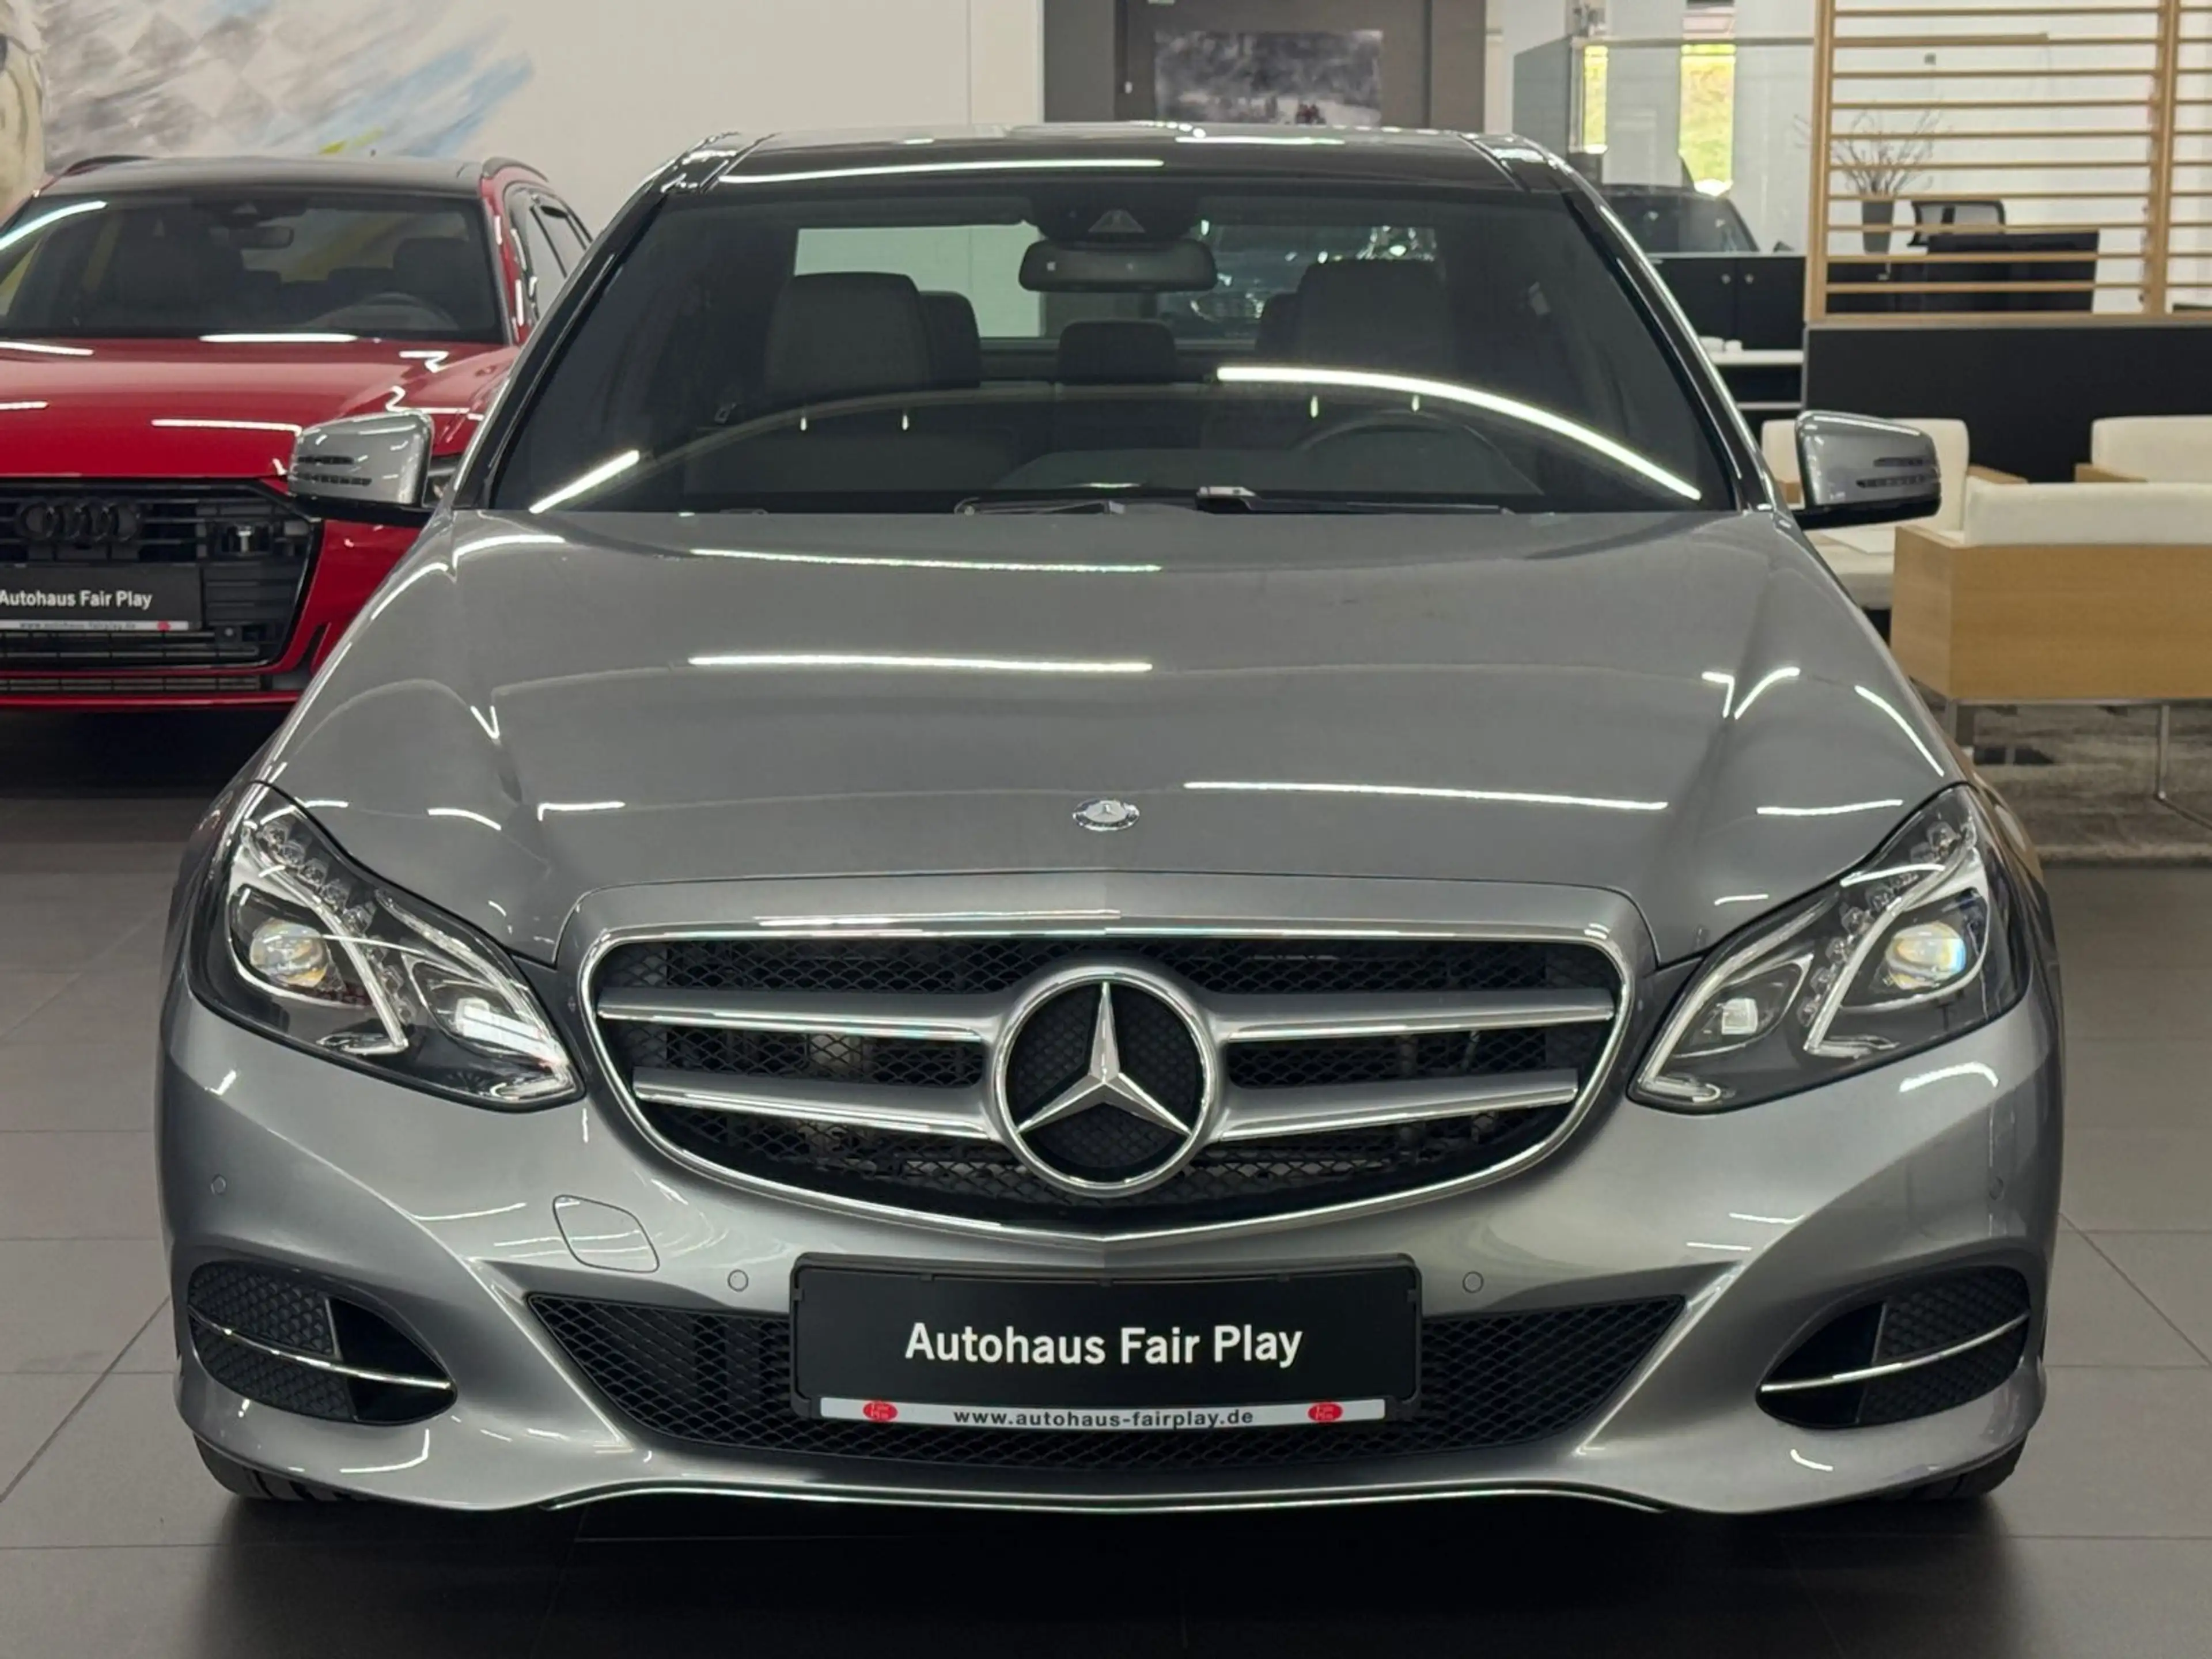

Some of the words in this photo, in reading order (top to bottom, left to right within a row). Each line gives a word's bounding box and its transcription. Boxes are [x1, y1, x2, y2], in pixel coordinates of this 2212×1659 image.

[0, 589, 76, 607] Autohaus
[79, 589, 112, 607] Fair
[115, 590, 153, 611] Play
[905, 1322, 1106, 1365] Autohaus
[1121, 1327, 1200, 1364] Fair
[1214, 1324, 1303, 1369] Play
[953, 1409, 1254, 1430] www.autohaus-fairplay.de
